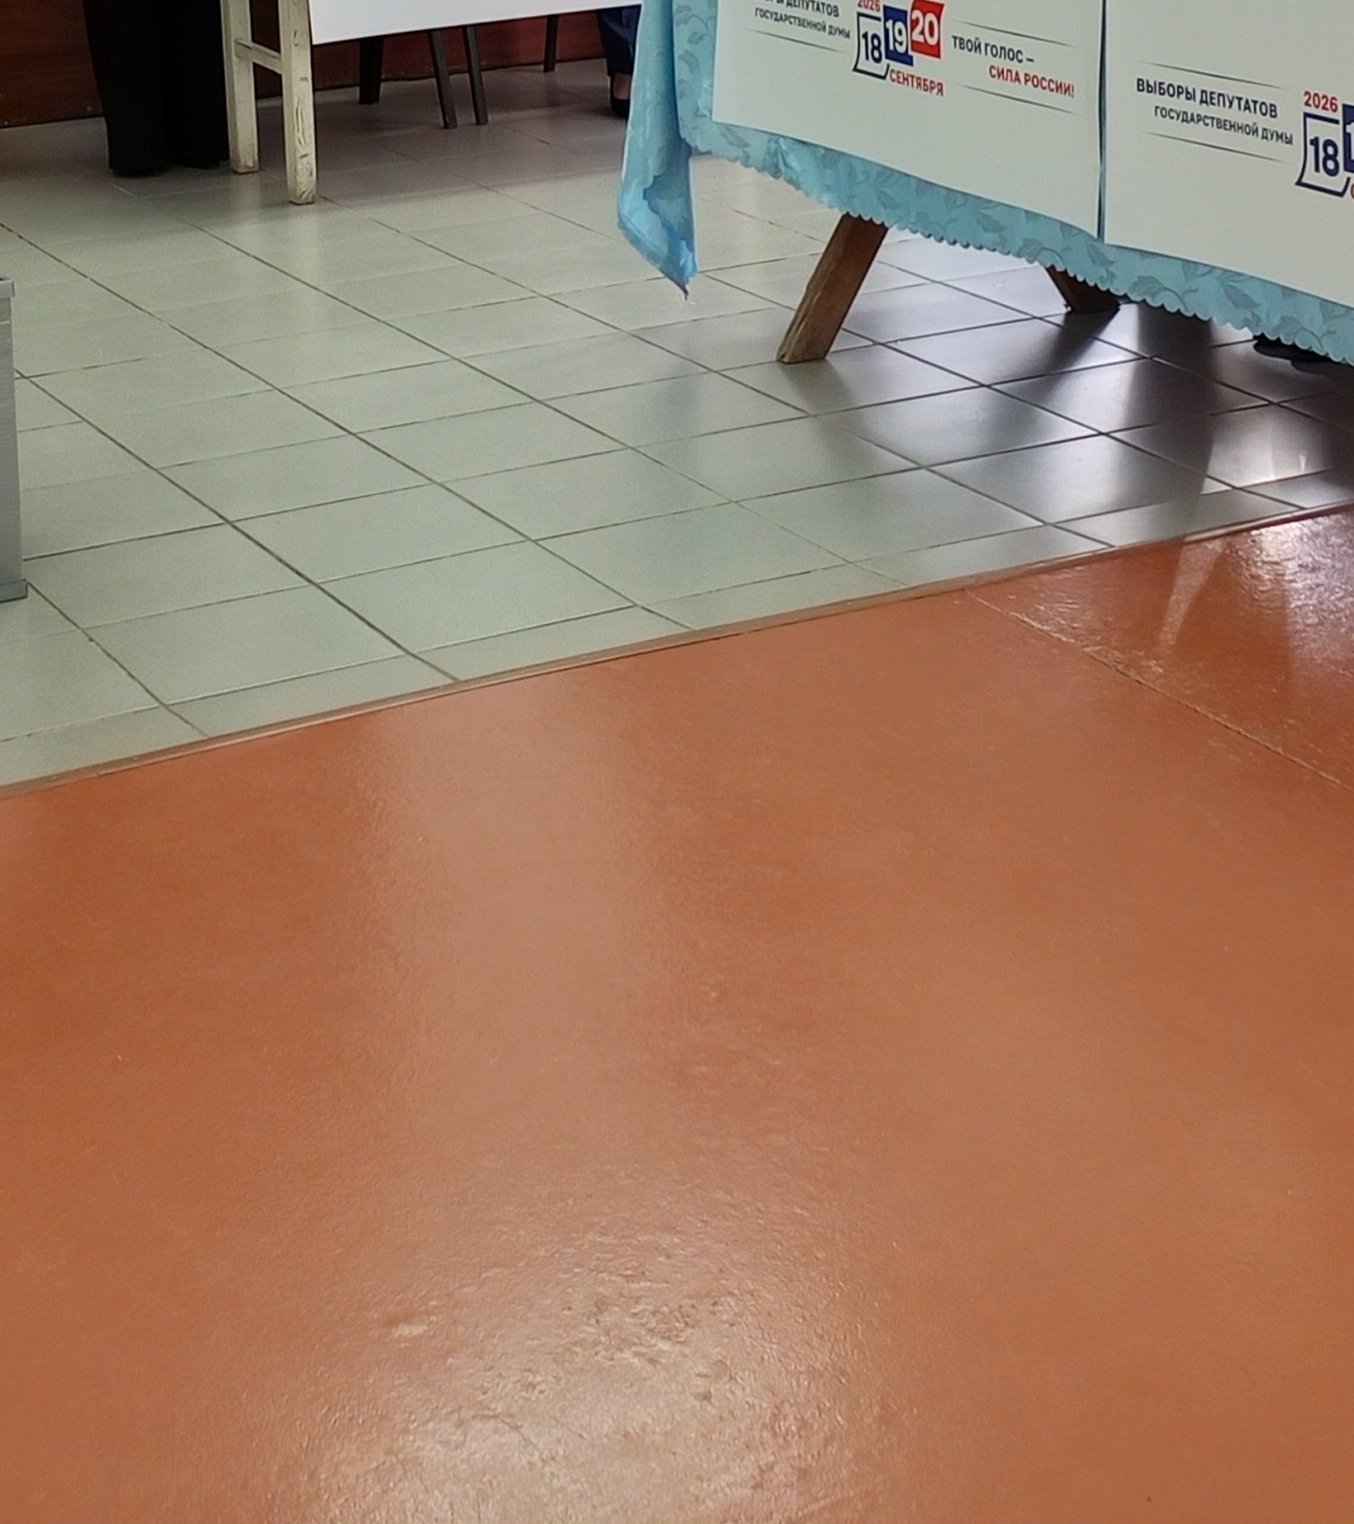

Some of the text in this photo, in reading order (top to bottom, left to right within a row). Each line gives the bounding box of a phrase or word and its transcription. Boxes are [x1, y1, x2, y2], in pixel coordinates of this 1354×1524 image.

[755, 7, 851, 39] ГОСУДАРСТВЕННОЙ ДУМЫ
[862, 9, 939, 64] 18 19 20
[951, 35, 982, 55] ТВОЙ
[984, 42, 1024, 64] ГОЛОС
[889, 68, 944, 96] СЕНТЯБРЯ
[989, 64, 1075, 98] СИЛА РОССИИ!
[1136, 78, 1278, 118] ВЫБОРЫ ДЕПУТАТОВ
[1303, 90, 1338, 113] 2026
[1154, 105, 1294, 146] ГОСУДАРСТВЕННОЙ ДУМЫ
[1309, 136, 1340, 177] 18
